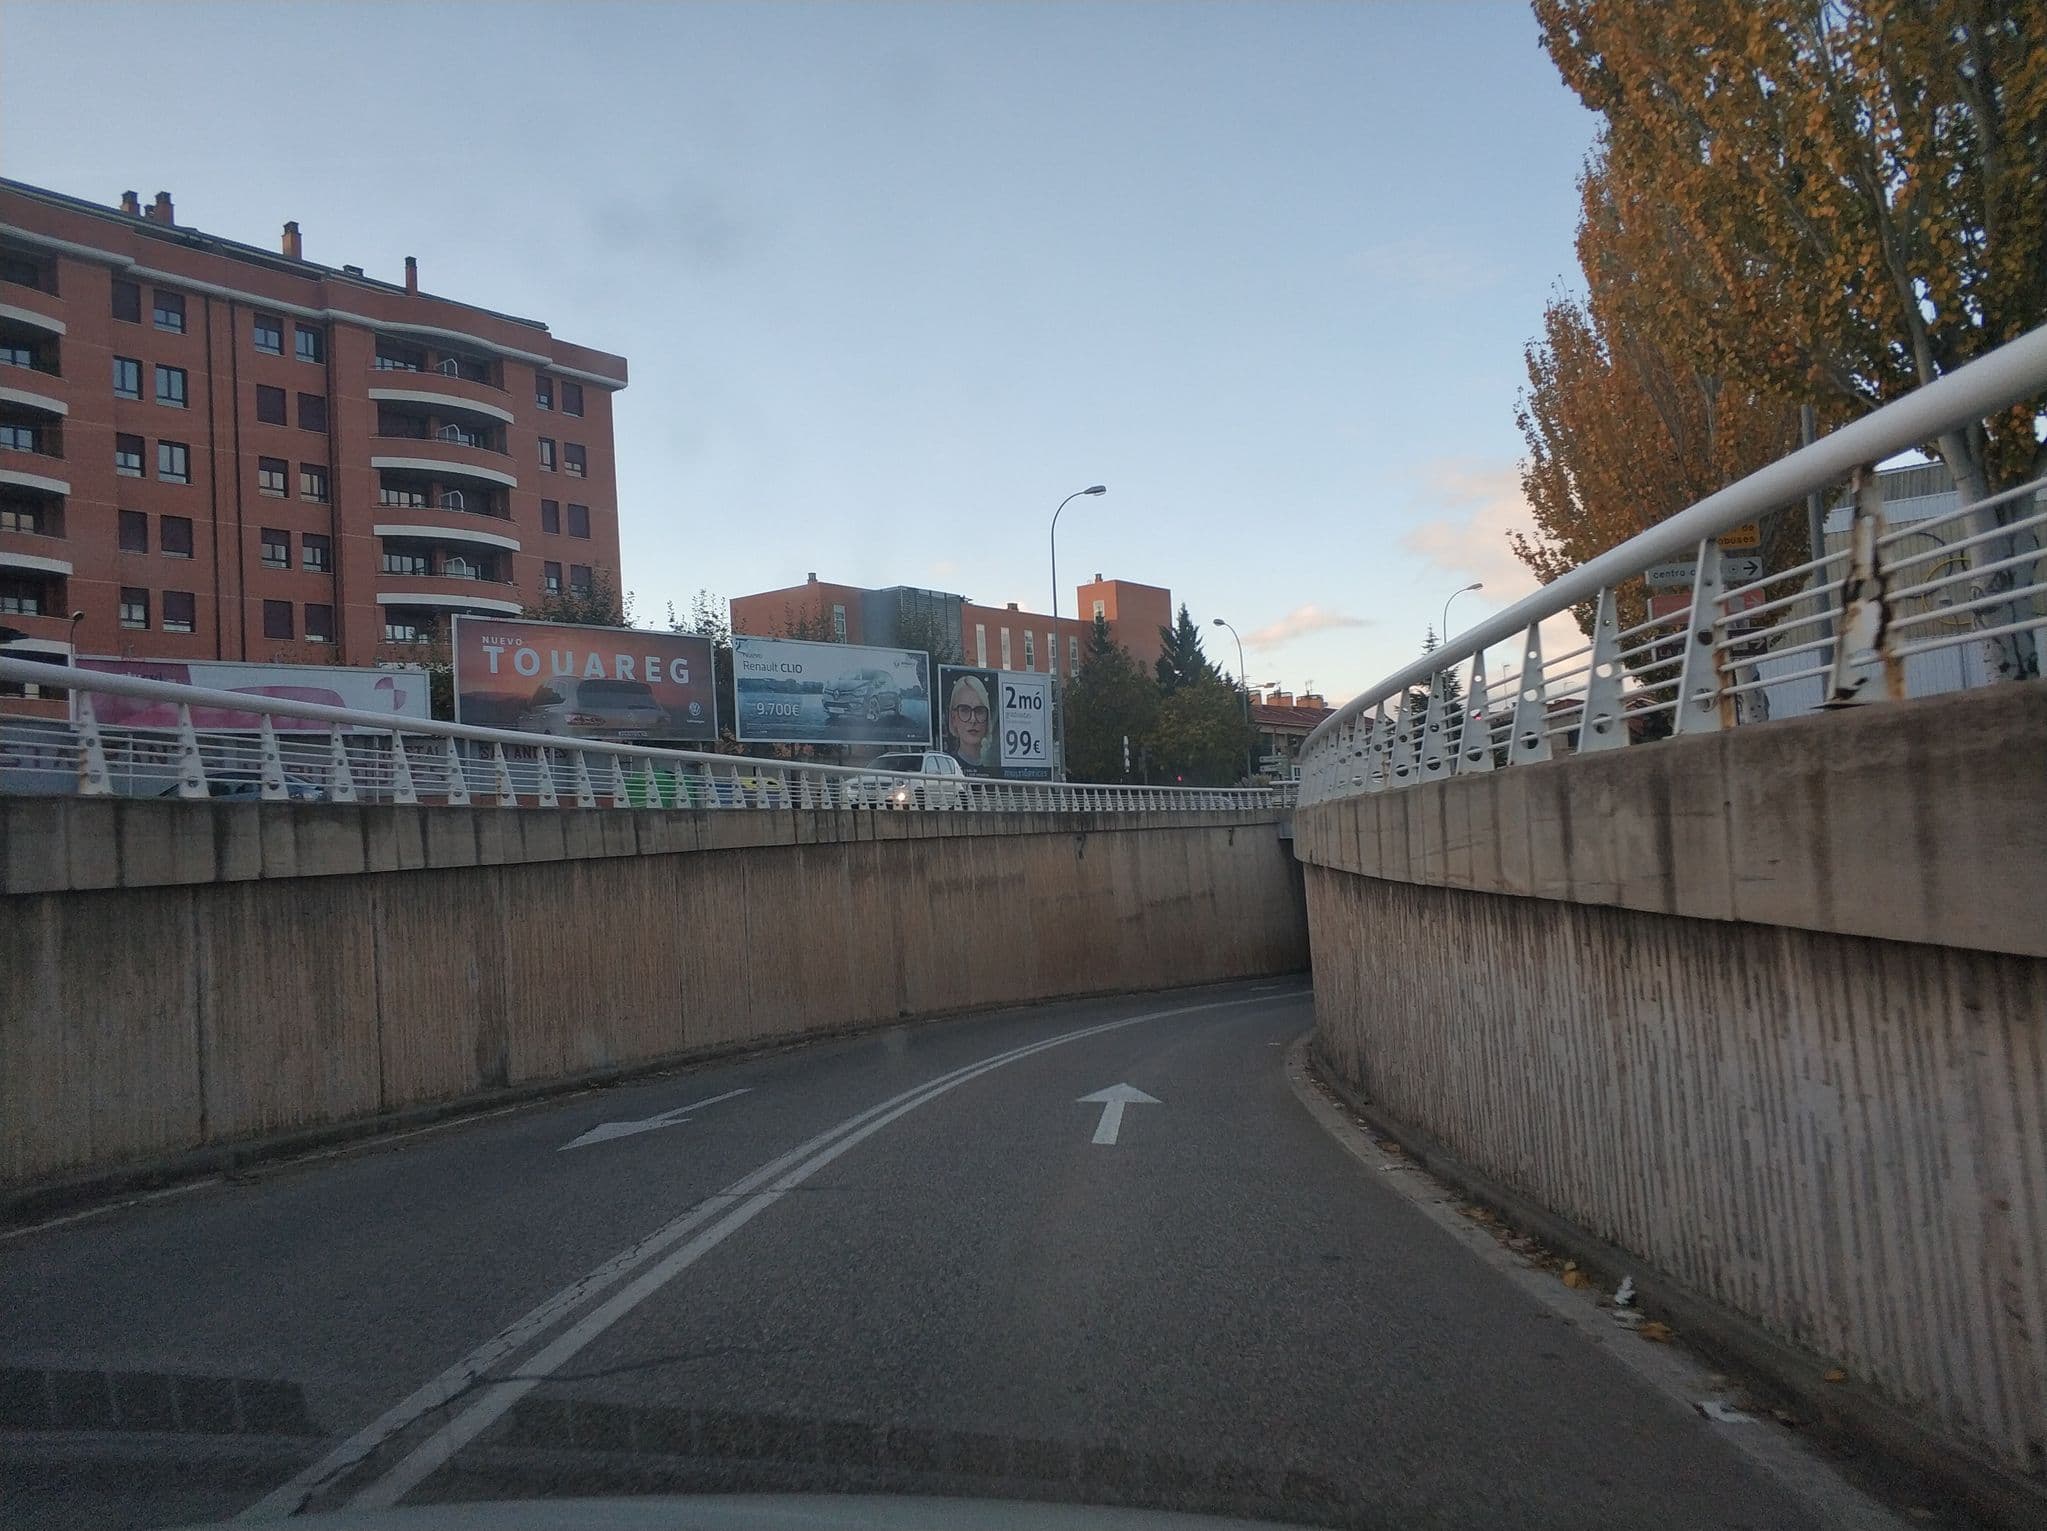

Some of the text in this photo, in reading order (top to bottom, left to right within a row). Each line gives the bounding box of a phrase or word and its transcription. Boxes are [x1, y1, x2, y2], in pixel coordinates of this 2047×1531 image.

[1653, 570, 1685, 579] centro
[482, 636, 522, 646] NUEVO
[483, 646, 689, 684] TOUAREG
[743, 660, 803, 674] Renault CLIO
[756, 702, 800, 716] 9.700€
